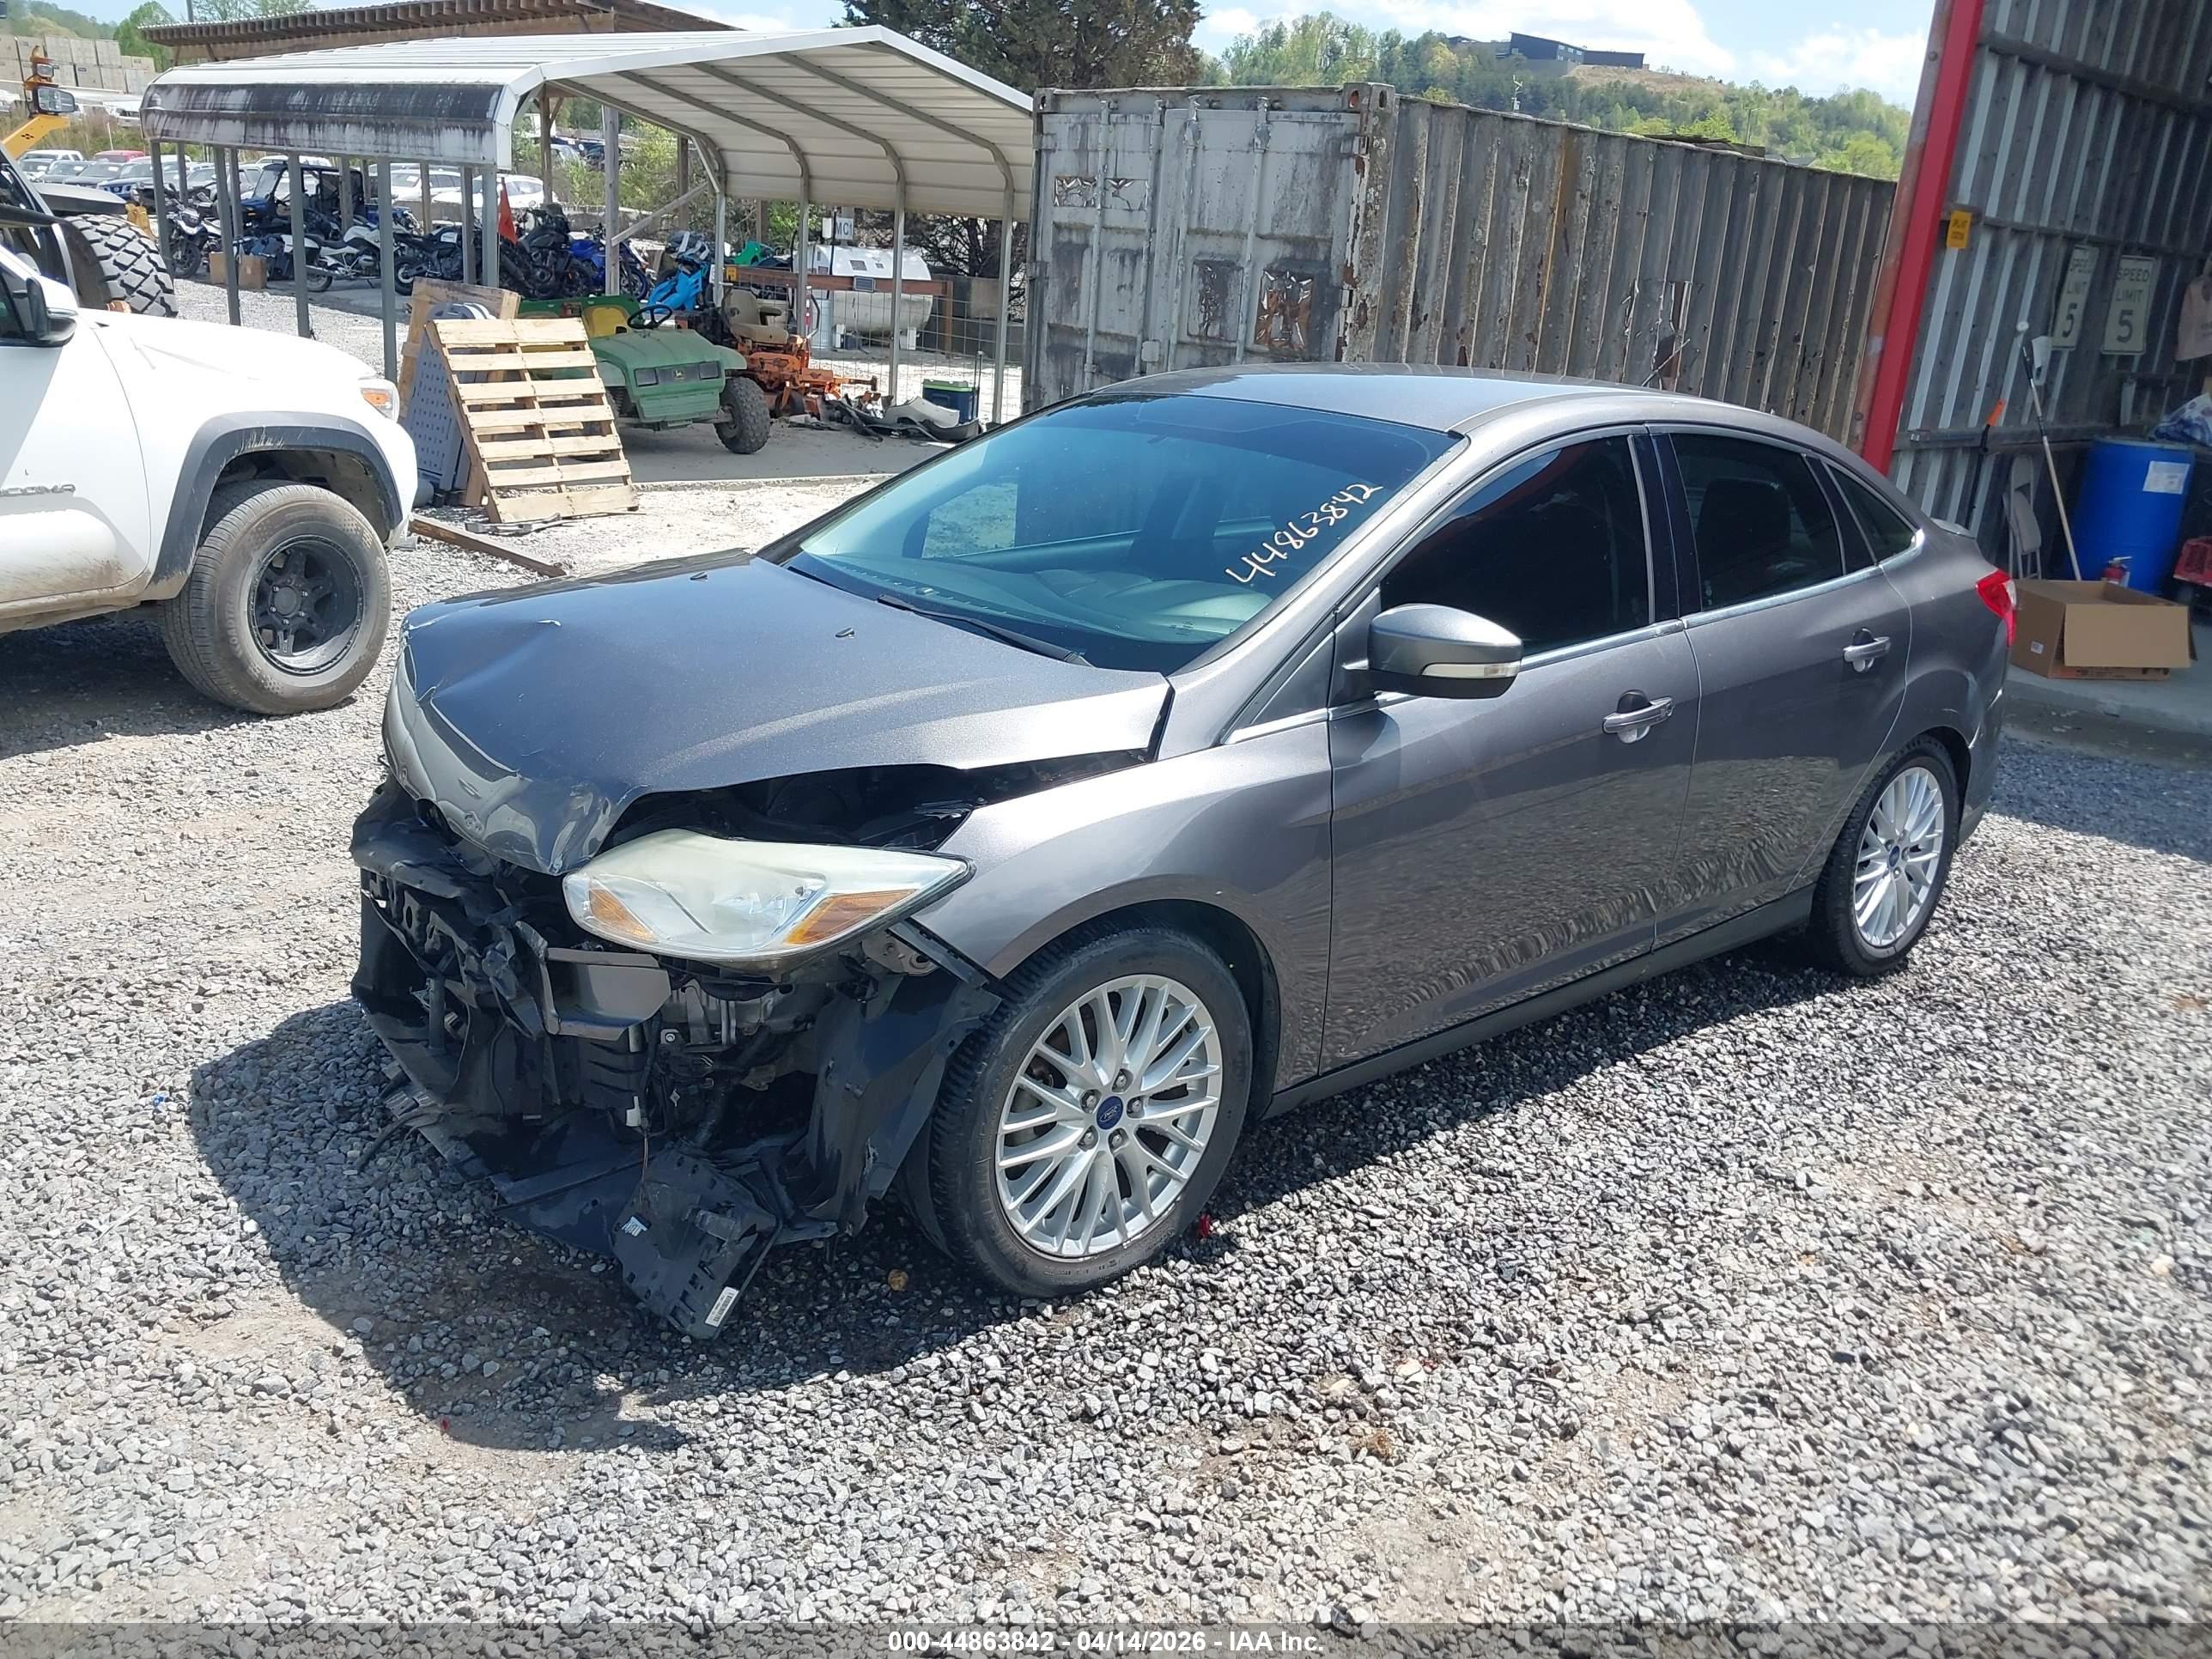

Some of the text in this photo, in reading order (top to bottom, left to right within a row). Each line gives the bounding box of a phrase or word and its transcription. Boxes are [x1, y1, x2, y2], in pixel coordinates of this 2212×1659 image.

[2116, 267, 2150, 283] SPEED
[2115, 289, 2144, 303] LIMIT
[2062, 302, 2078, 338] 5
[2116, 309, 2135, 343] 5
[1225, 483, 1384, 583] 44863842
